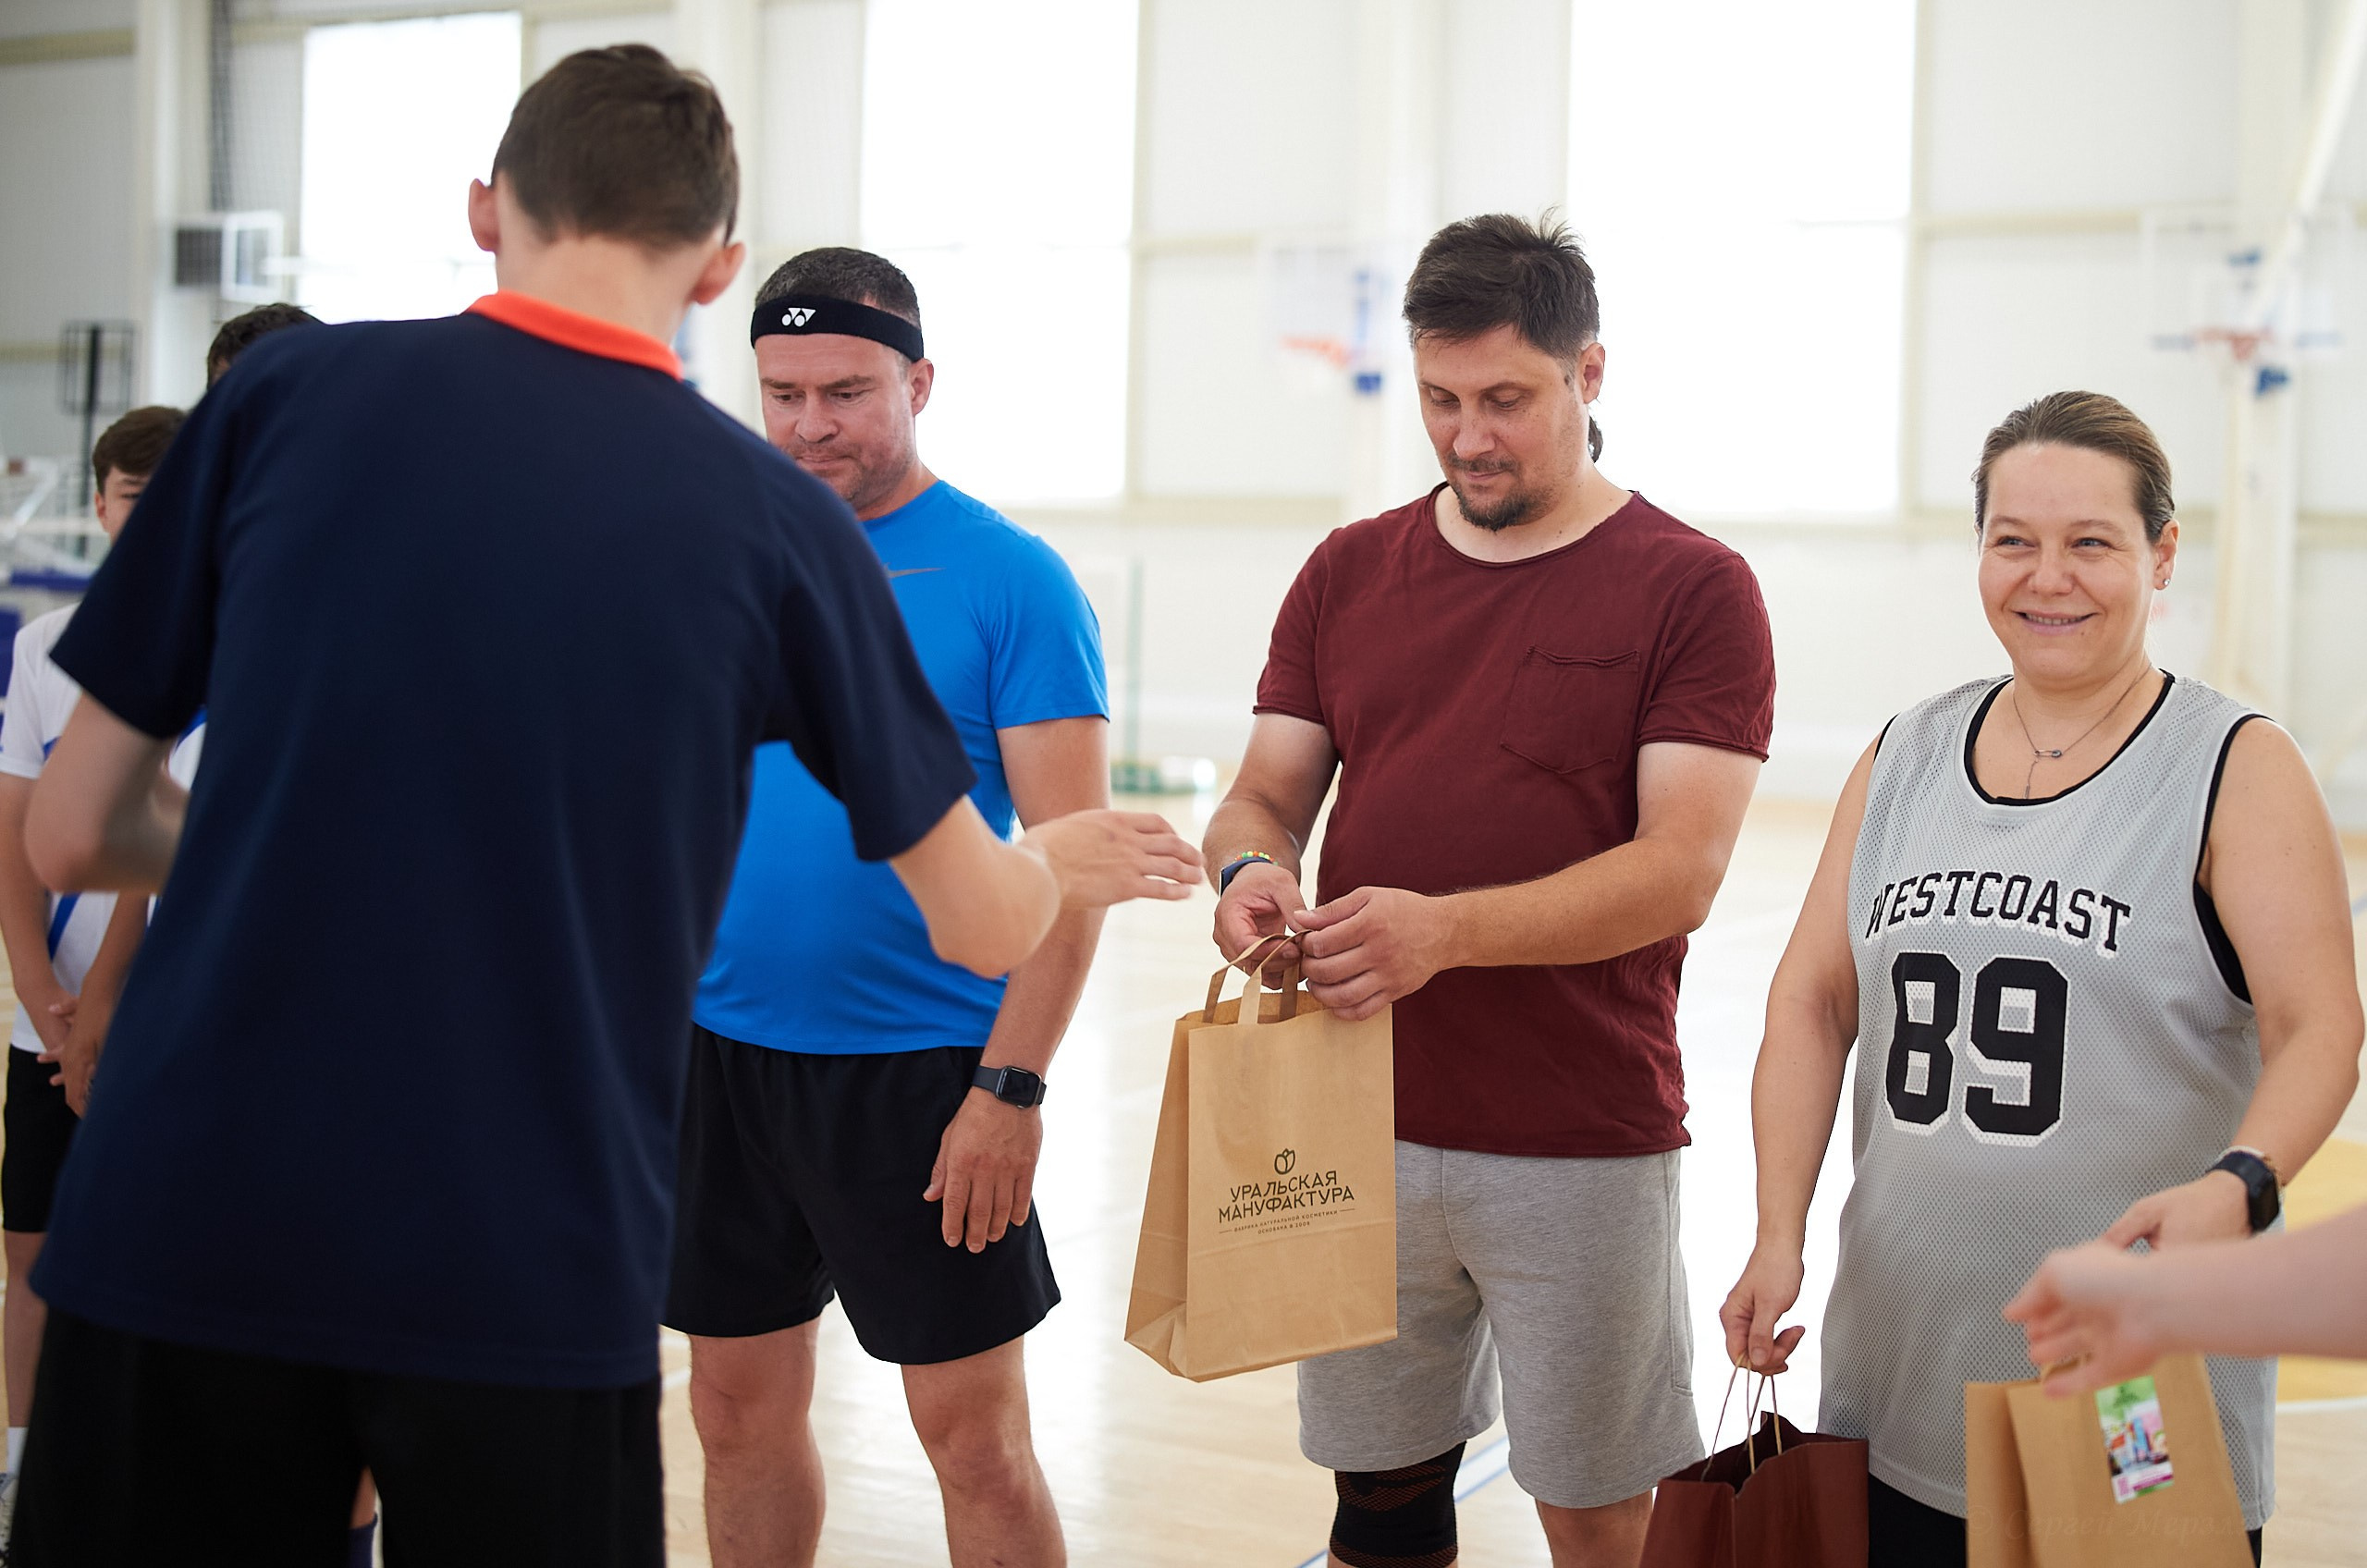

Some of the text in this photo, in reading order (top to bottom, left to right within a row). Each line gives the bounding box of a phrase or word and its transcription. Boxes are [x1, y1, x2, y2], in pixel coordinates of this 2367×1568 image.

[1865, 870, 2131, 952] WESTCOAST
[1884, 950, 2069, 1138] 89
[1218, 1185, 1355, 1224] МАНУФАКТУРА
[1230, 1170, 1338, 1203] УРАЛЬСКАЯ
[1301, 1210, 1338, 1219] КОСМЕТИКИ
